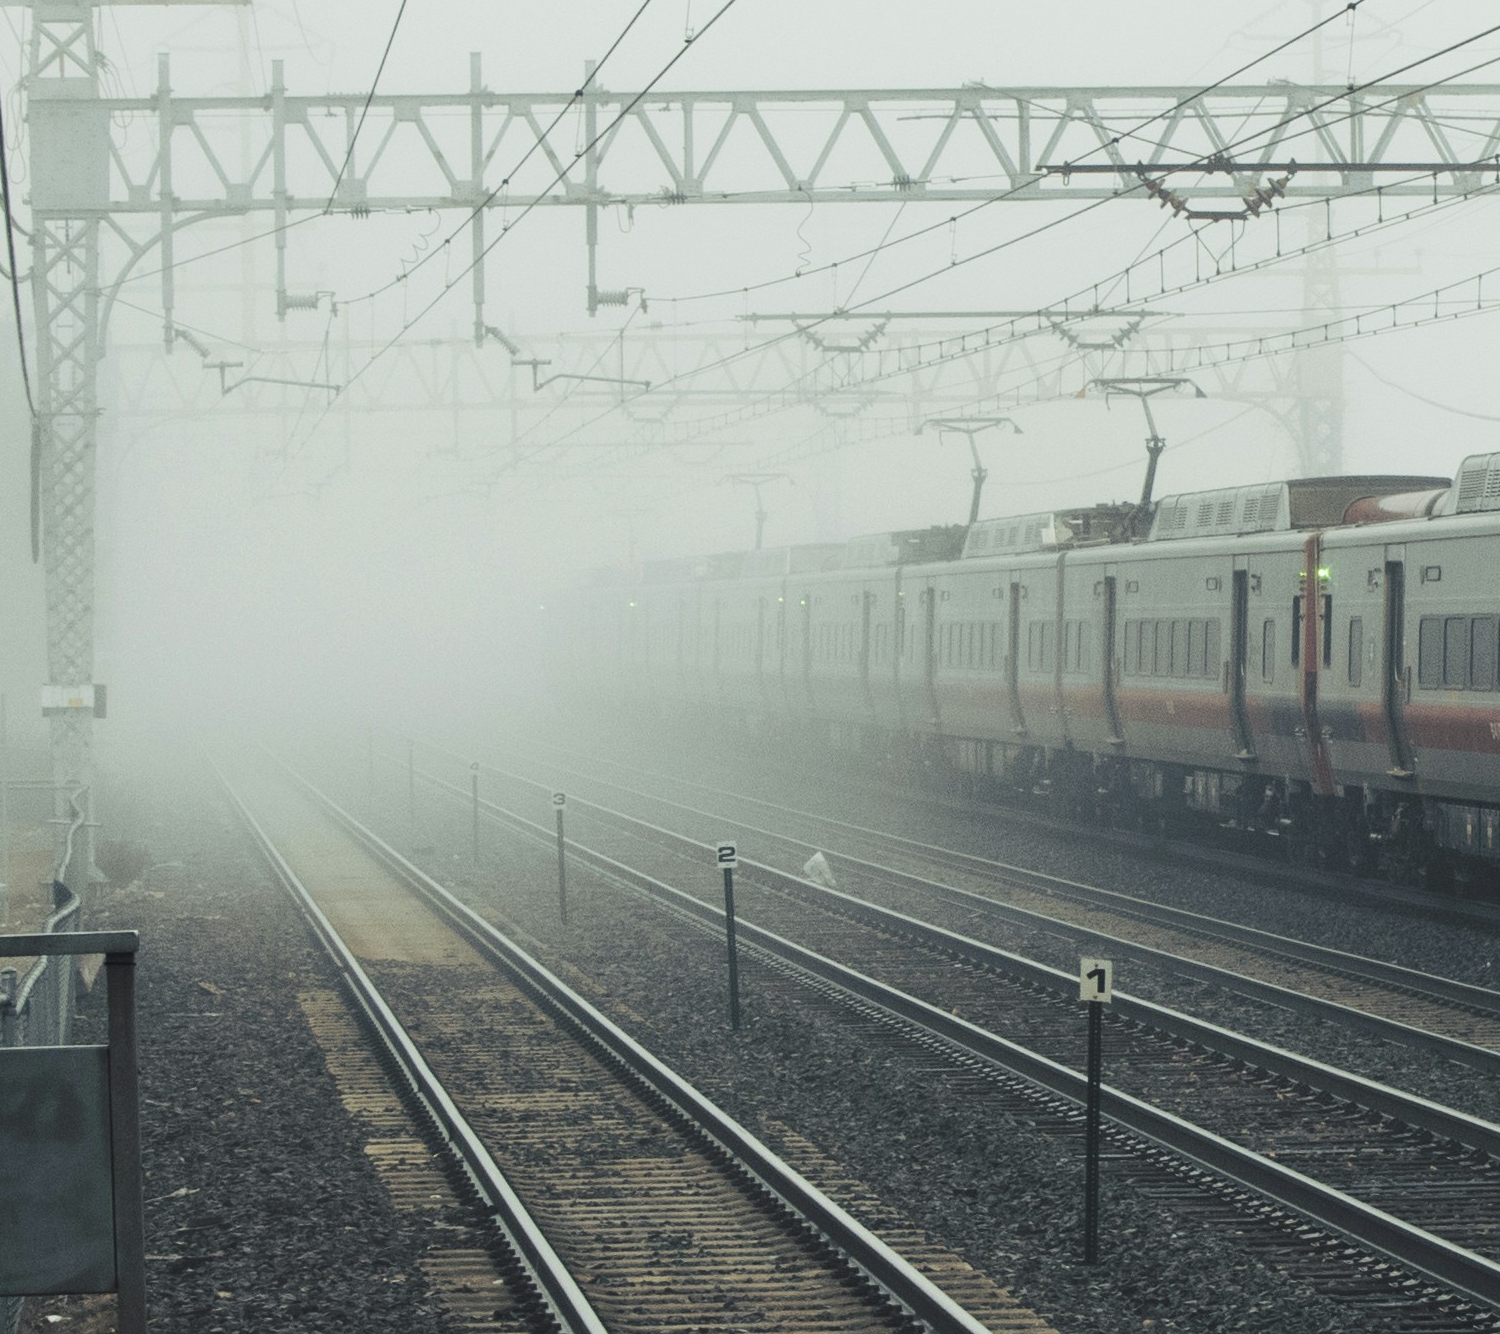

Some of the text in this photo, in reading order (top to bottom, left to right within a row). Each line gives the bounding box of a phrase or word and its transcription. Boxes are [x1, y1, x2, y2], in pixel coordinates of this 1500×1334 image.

[553, 792, 566, 806] 3
[717, 846, 736, 863] 2
[1086, 969, 1106, 993] 1
